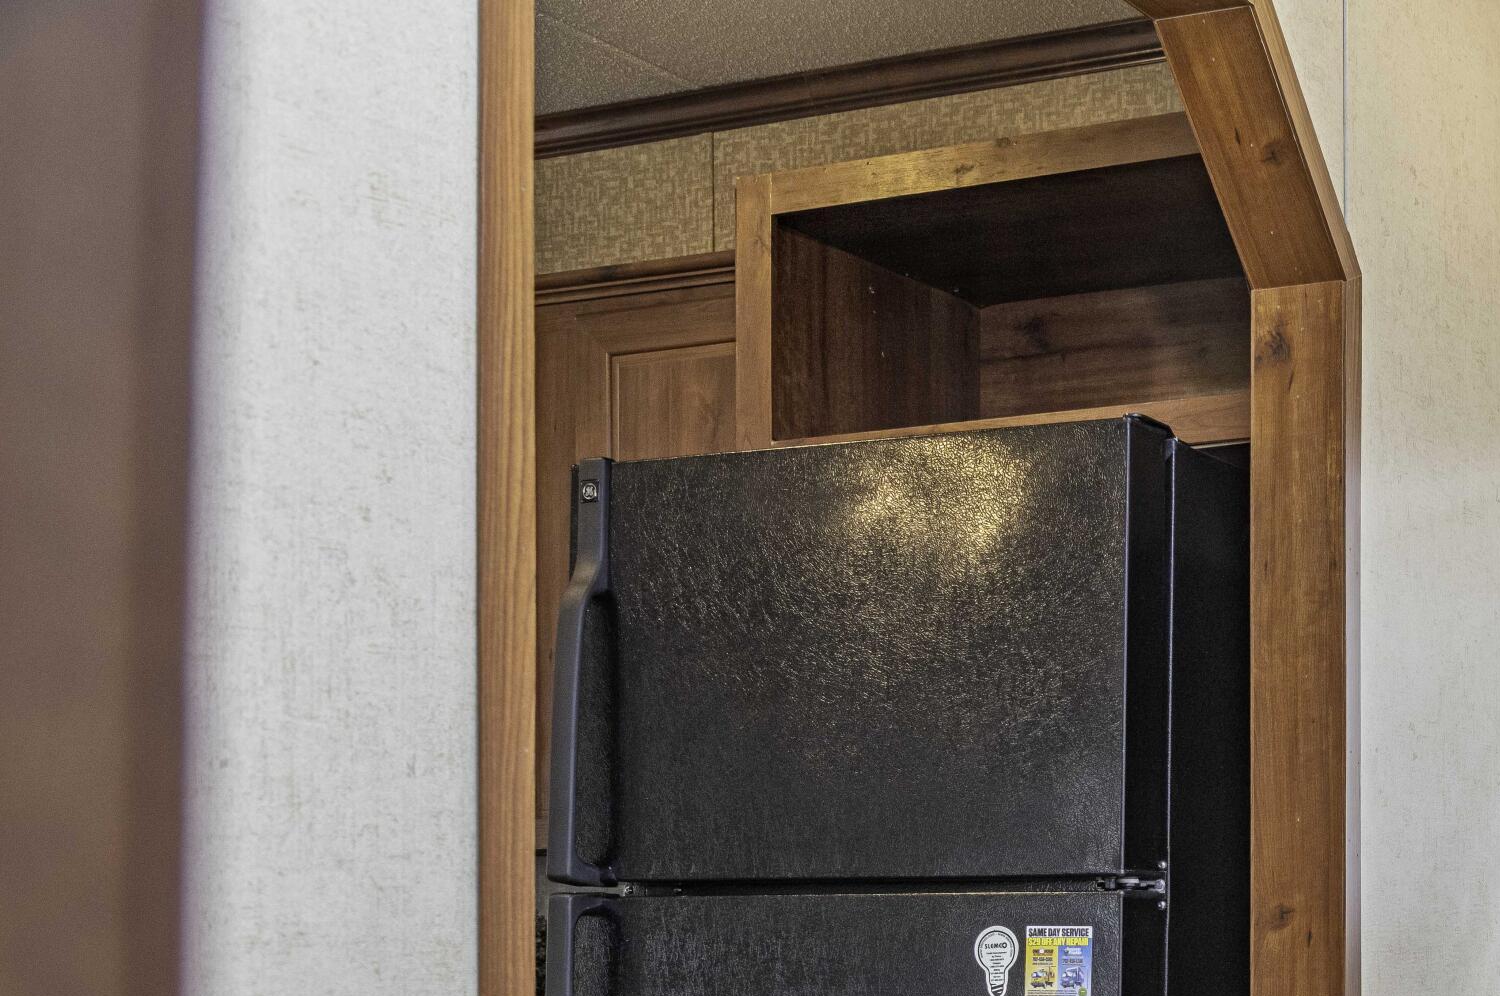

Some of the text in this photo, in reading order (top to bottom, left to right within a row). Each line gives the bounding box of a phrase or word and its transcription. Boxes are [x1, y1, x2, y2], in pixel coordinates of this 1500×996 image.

[1028, 928, 1089, 937] SAME DAY SERVICE
[1028, 937, 1088, 946] $29 OFF ANY REPAIR
